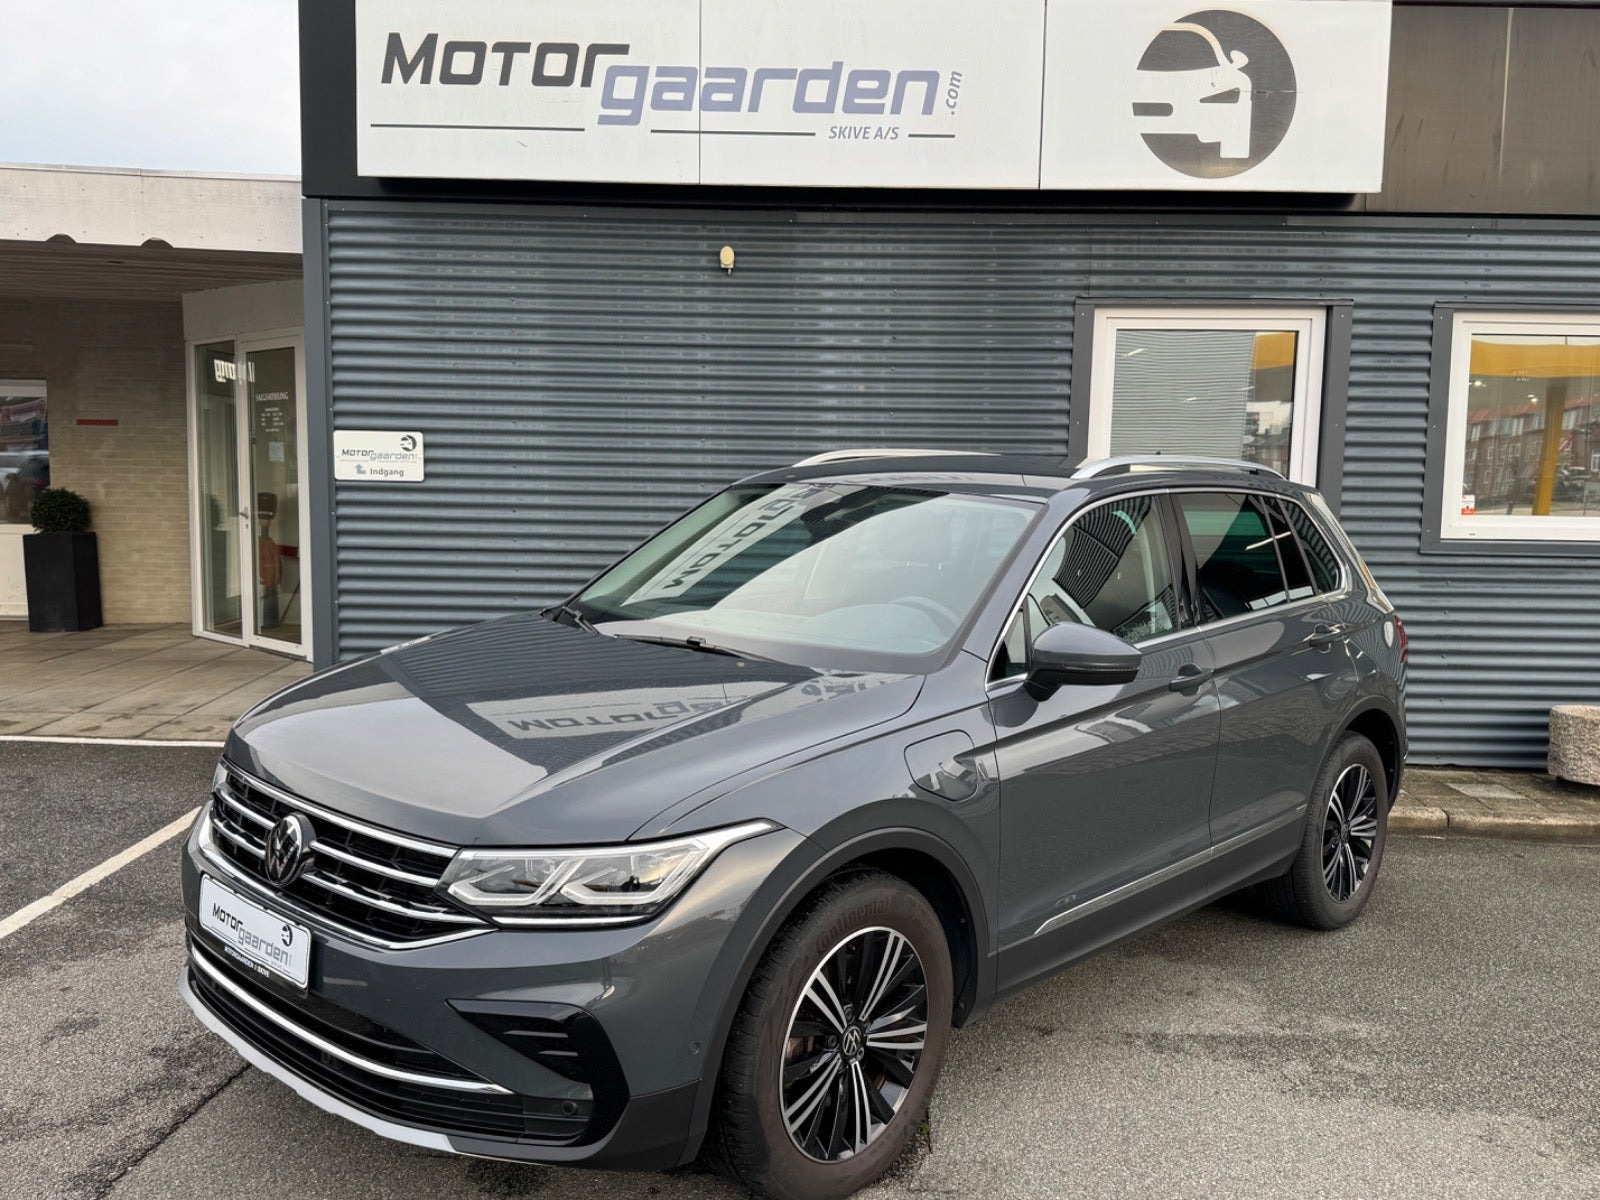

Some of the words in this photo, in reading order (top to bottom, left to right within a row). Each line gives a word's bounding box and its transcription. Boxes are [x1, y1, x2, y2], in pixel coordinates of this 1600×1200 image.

[945, 70, 963, 116] .com
[828, 125, 872, 140] SKIVE
[873, 126, 900, 140] A/S
[370, 467, 405, 477] Indgang
